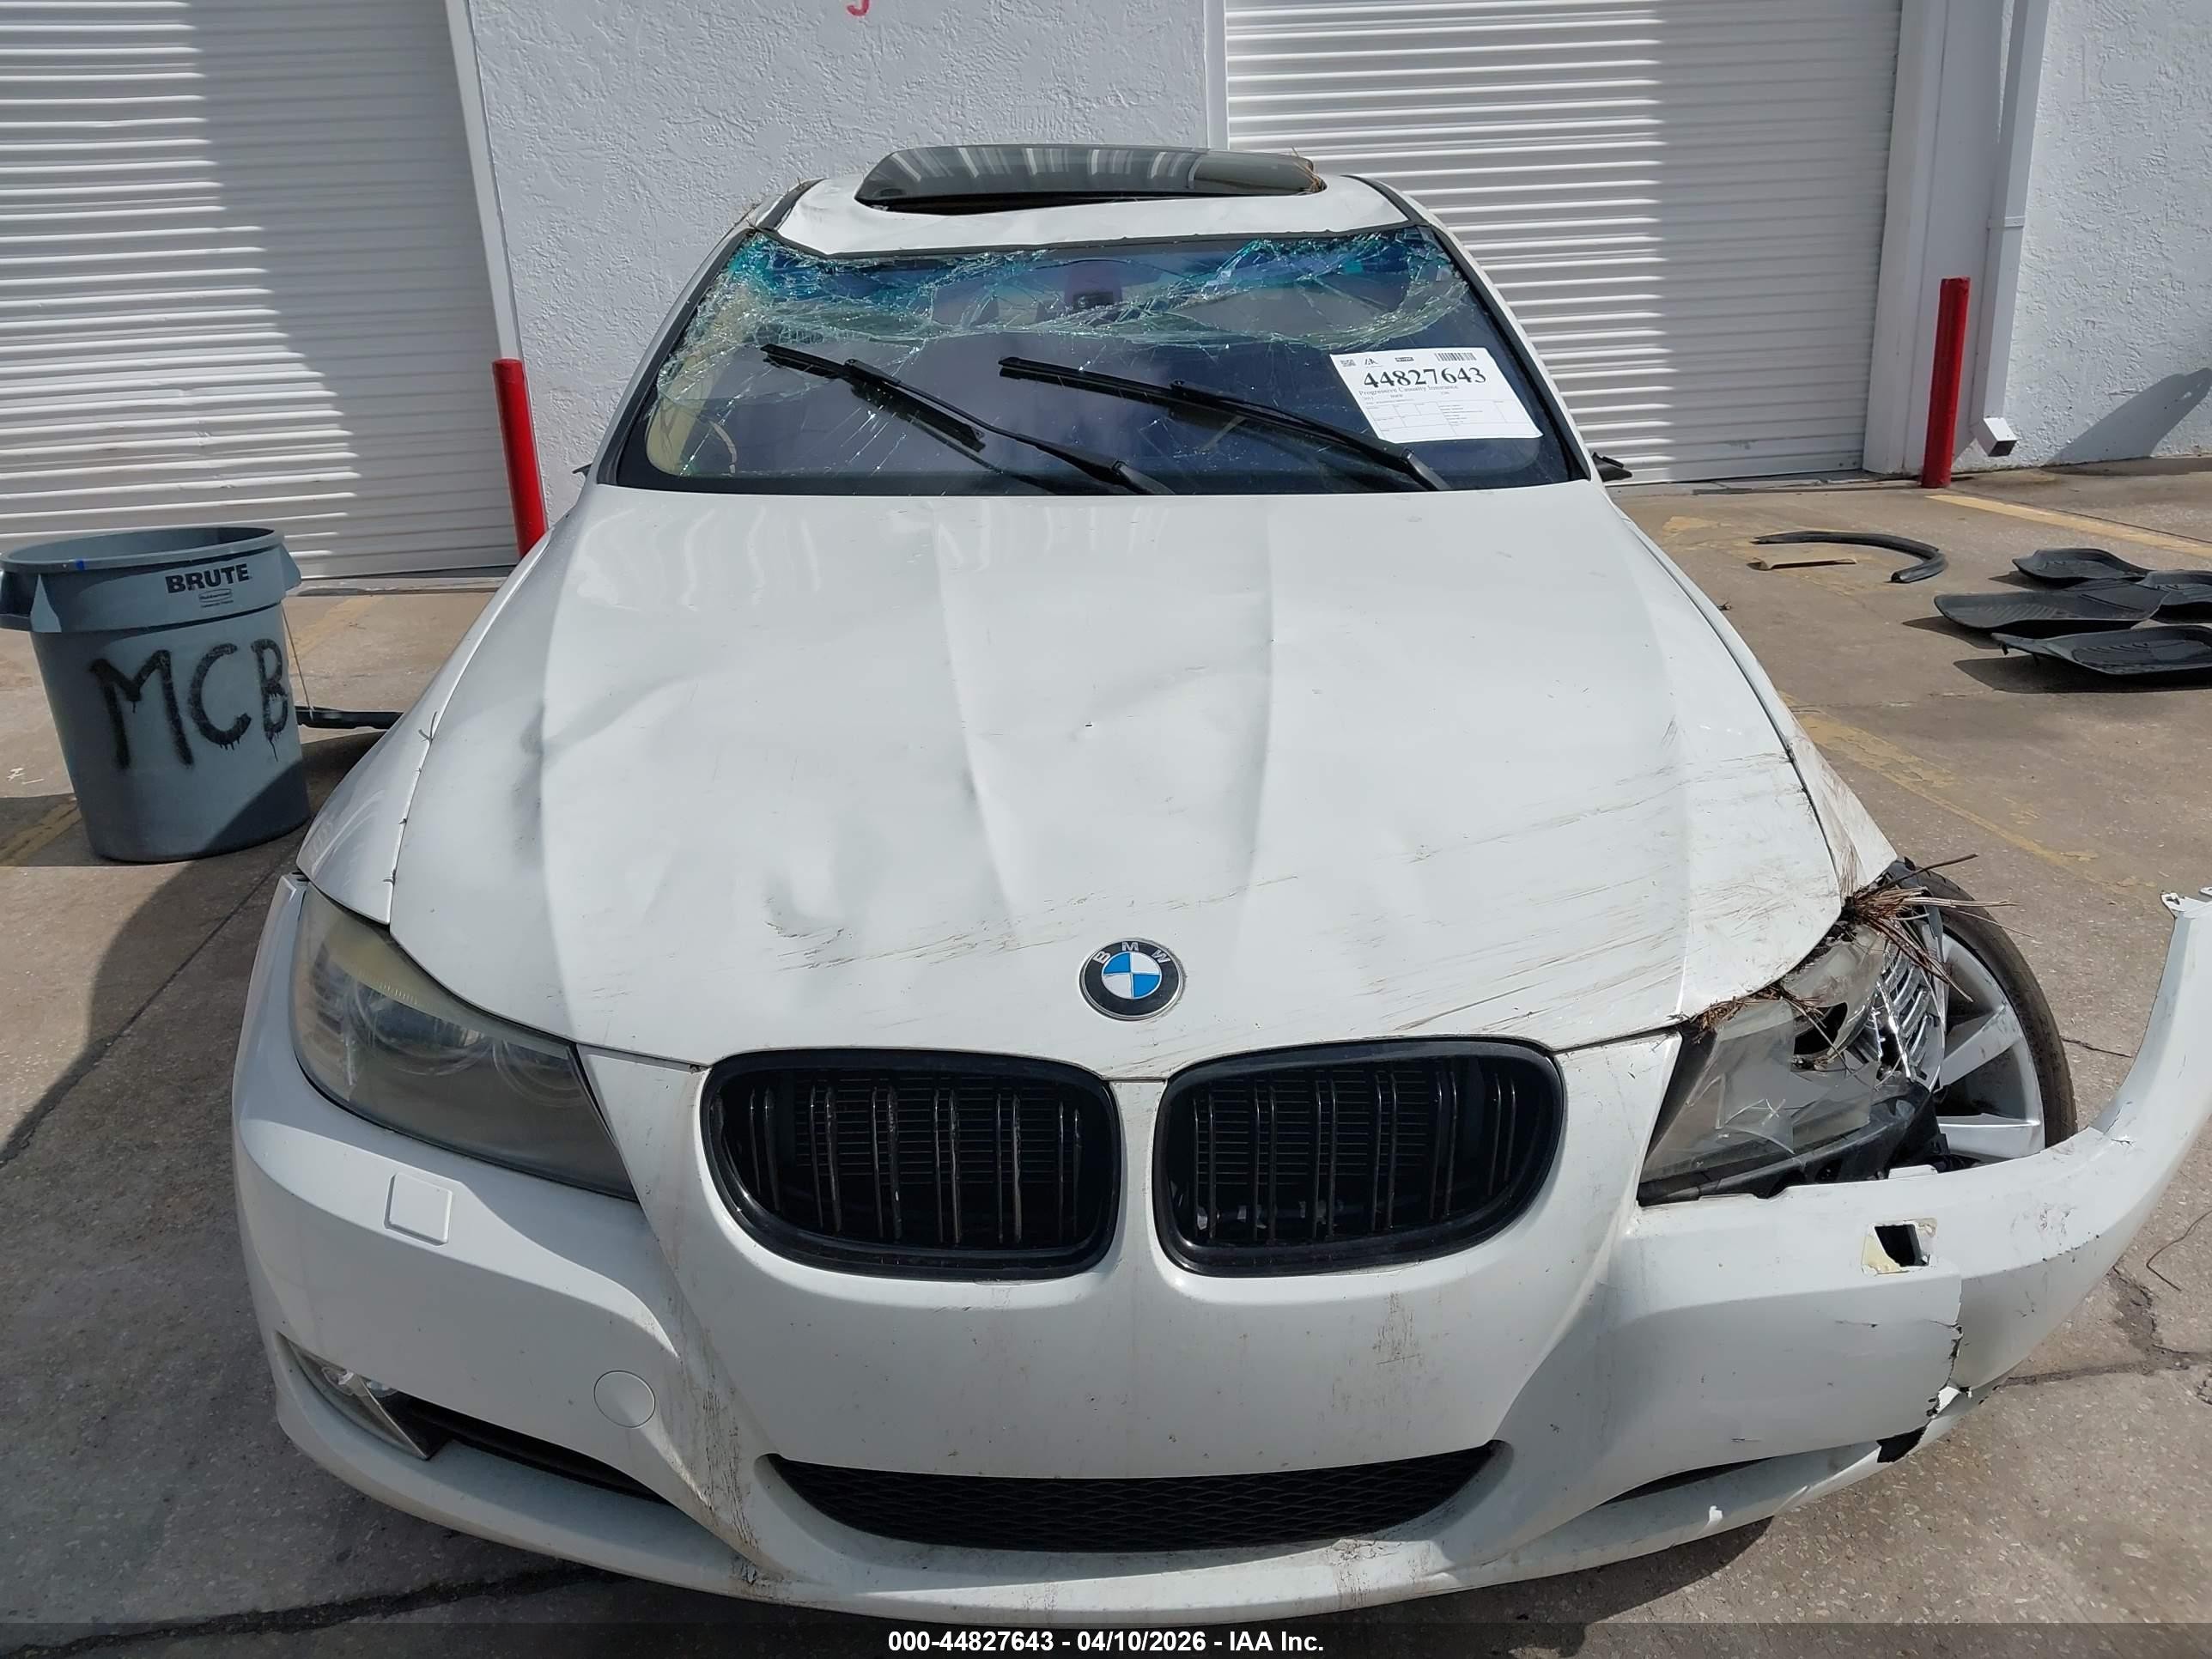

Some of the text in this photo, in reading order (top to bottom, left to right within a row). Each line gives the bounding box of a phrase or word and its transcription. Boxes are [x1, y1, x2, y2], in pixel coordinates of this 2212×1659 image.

[1364, 368, 1486, 388] 44827643
[165, 563, 252, 593] BRUTE
[89, 639, 289, 769] MCB
[1092, 941, 1171, 964] BMW
